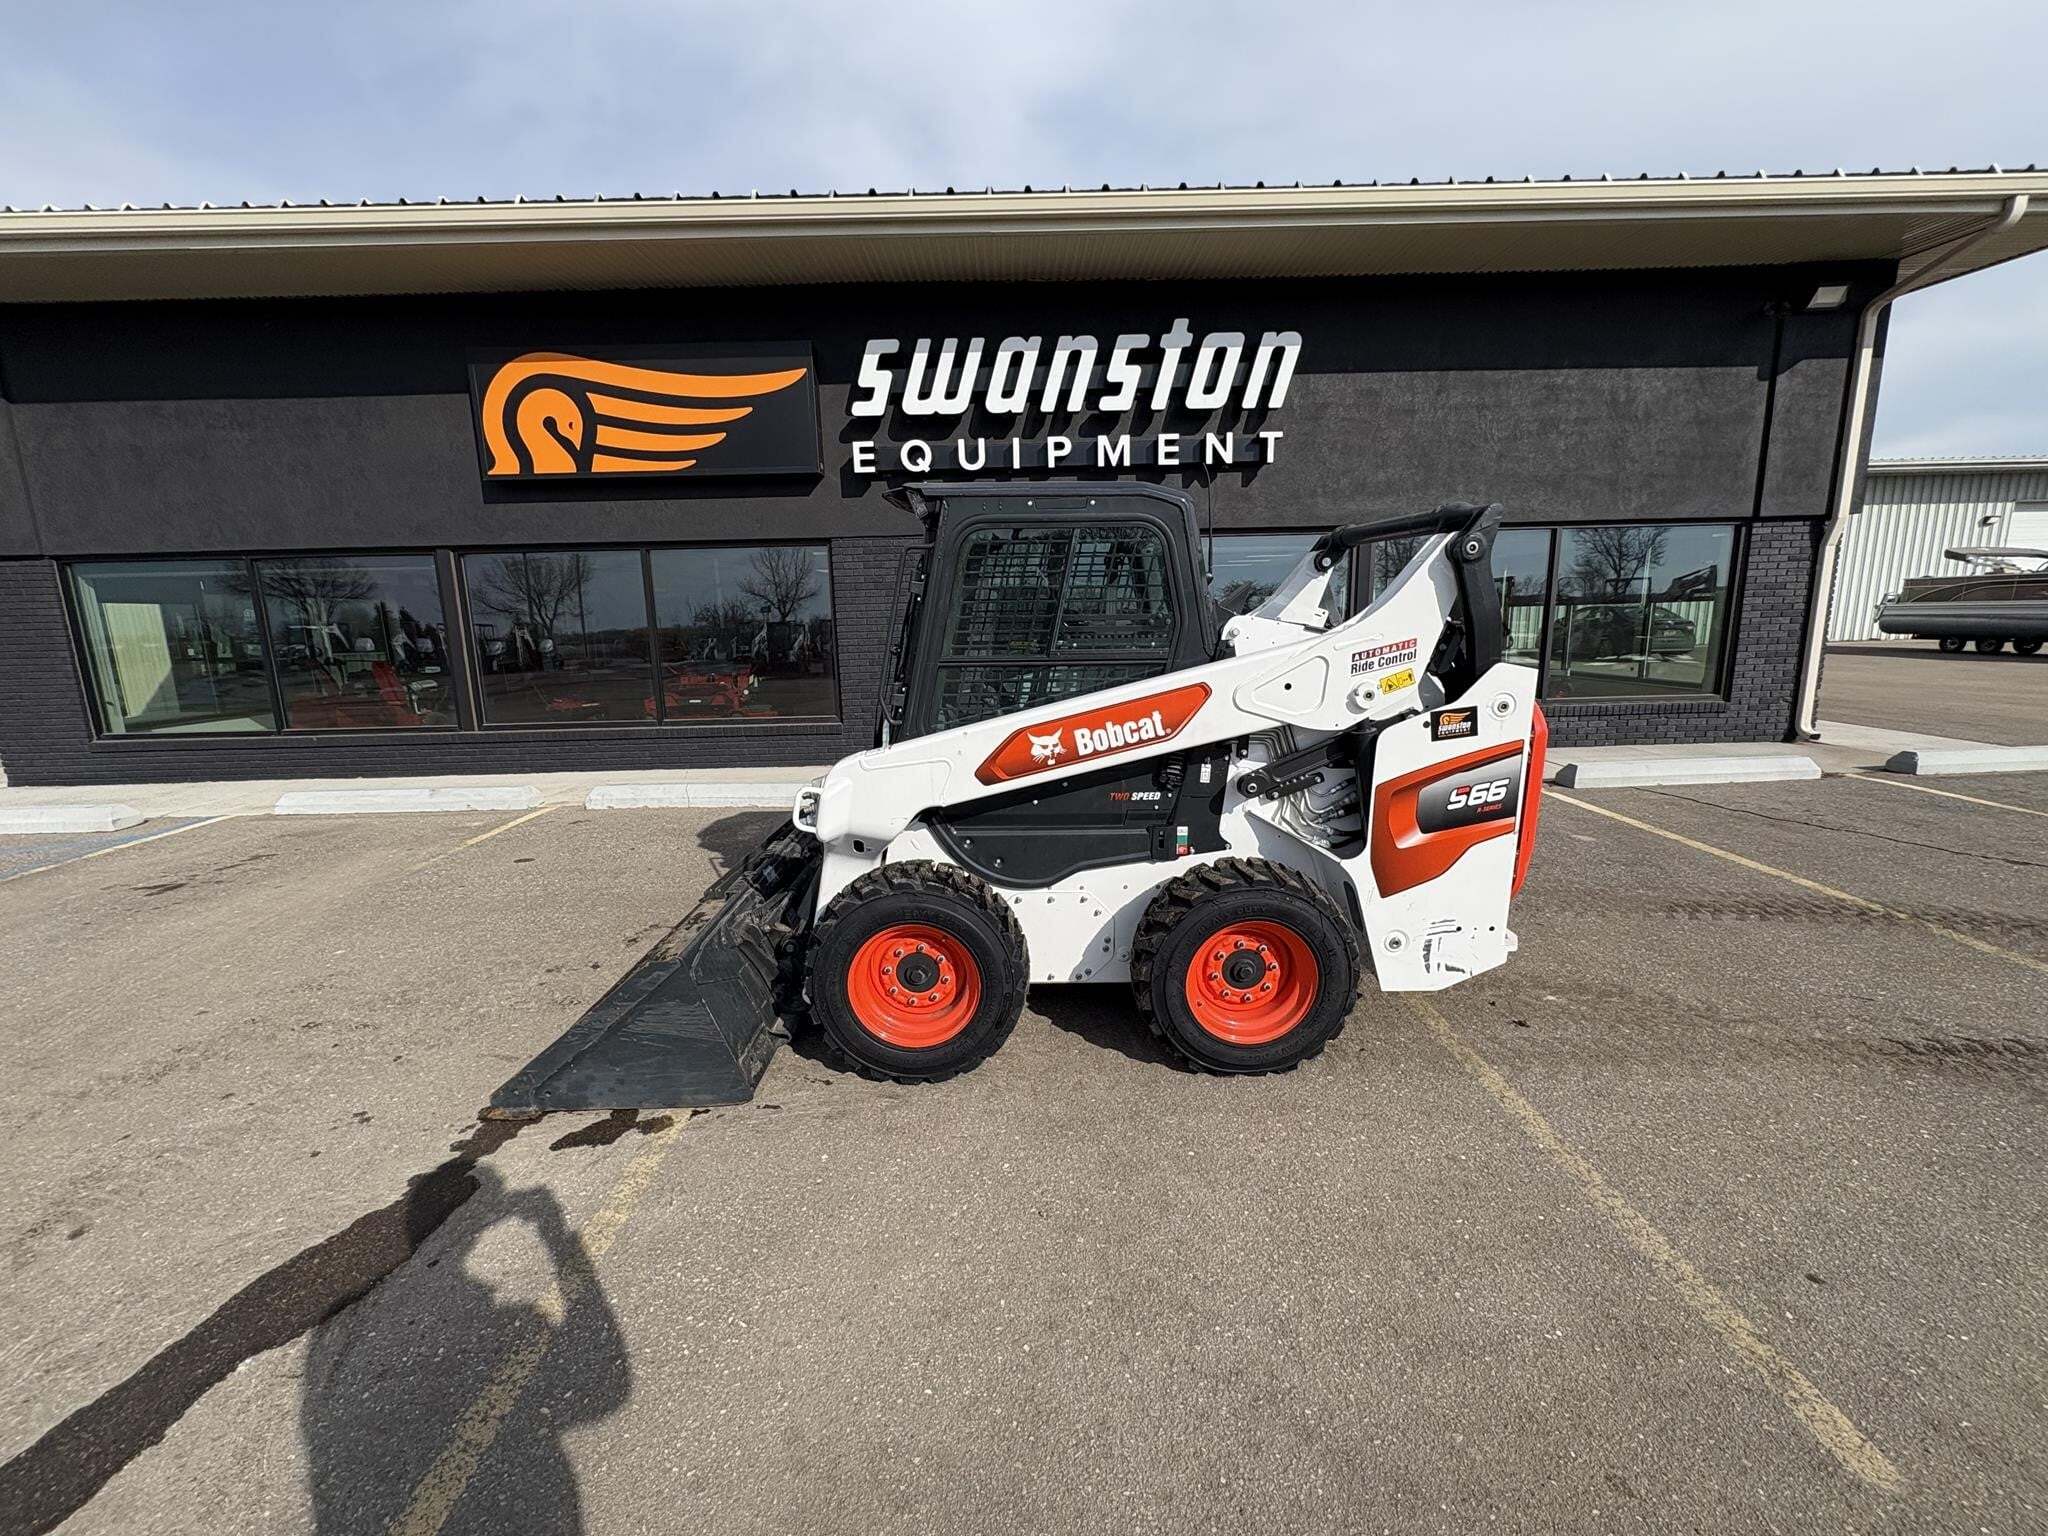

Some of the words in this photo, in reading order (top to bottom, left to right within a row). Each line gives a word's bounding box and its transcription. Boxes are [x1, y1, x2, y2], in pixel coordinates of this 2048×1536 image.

[852, 431, 1283, 474] EQUIPMENT
[1351, 660, 1375, 675] Ride
[1378, 648, 1417, 668] Control
[1353, 639, 1416, 661] AUTOMATIC
[1073, 710, 1167, 757] Bobcat
[1110, 792, 1130, 801] TWO
[1131, 791, 1161, 801] SPEED
[1446, 778, 1510, 811] S66
